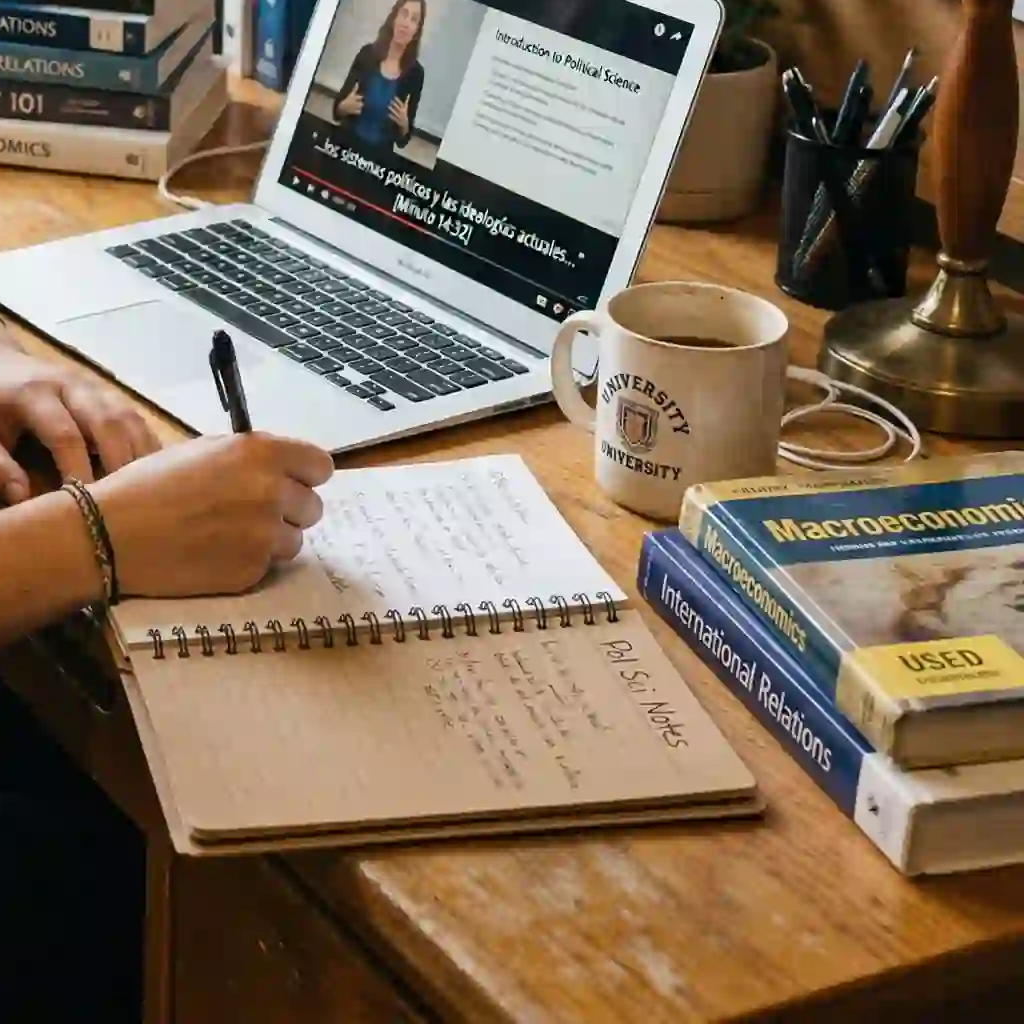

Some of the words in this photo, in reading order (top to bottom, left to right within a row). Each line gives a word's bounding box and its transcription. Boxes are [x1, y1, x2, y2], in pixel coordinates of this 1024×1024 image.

[494, 27, 551, 59] Introduction
[564, 53, 603, 82] Political
[603, 67, 643, 96] Science
[10, 91, 44, 114] 101
[600, 372, 692, 436] UNIVERSITY
[600, 438, 683, 482] UNIVERSITY
[703, 523, 807, 653] Macroeconomics
[598, 639, 639, 665] Pol
[660, 572, 757, 693] International
[758, 670, 833, 774] Relations
[897, 649, 983, 672] USED
[618, 669, 657, 694] Sci
[638, 700, 690, 750] Notes
